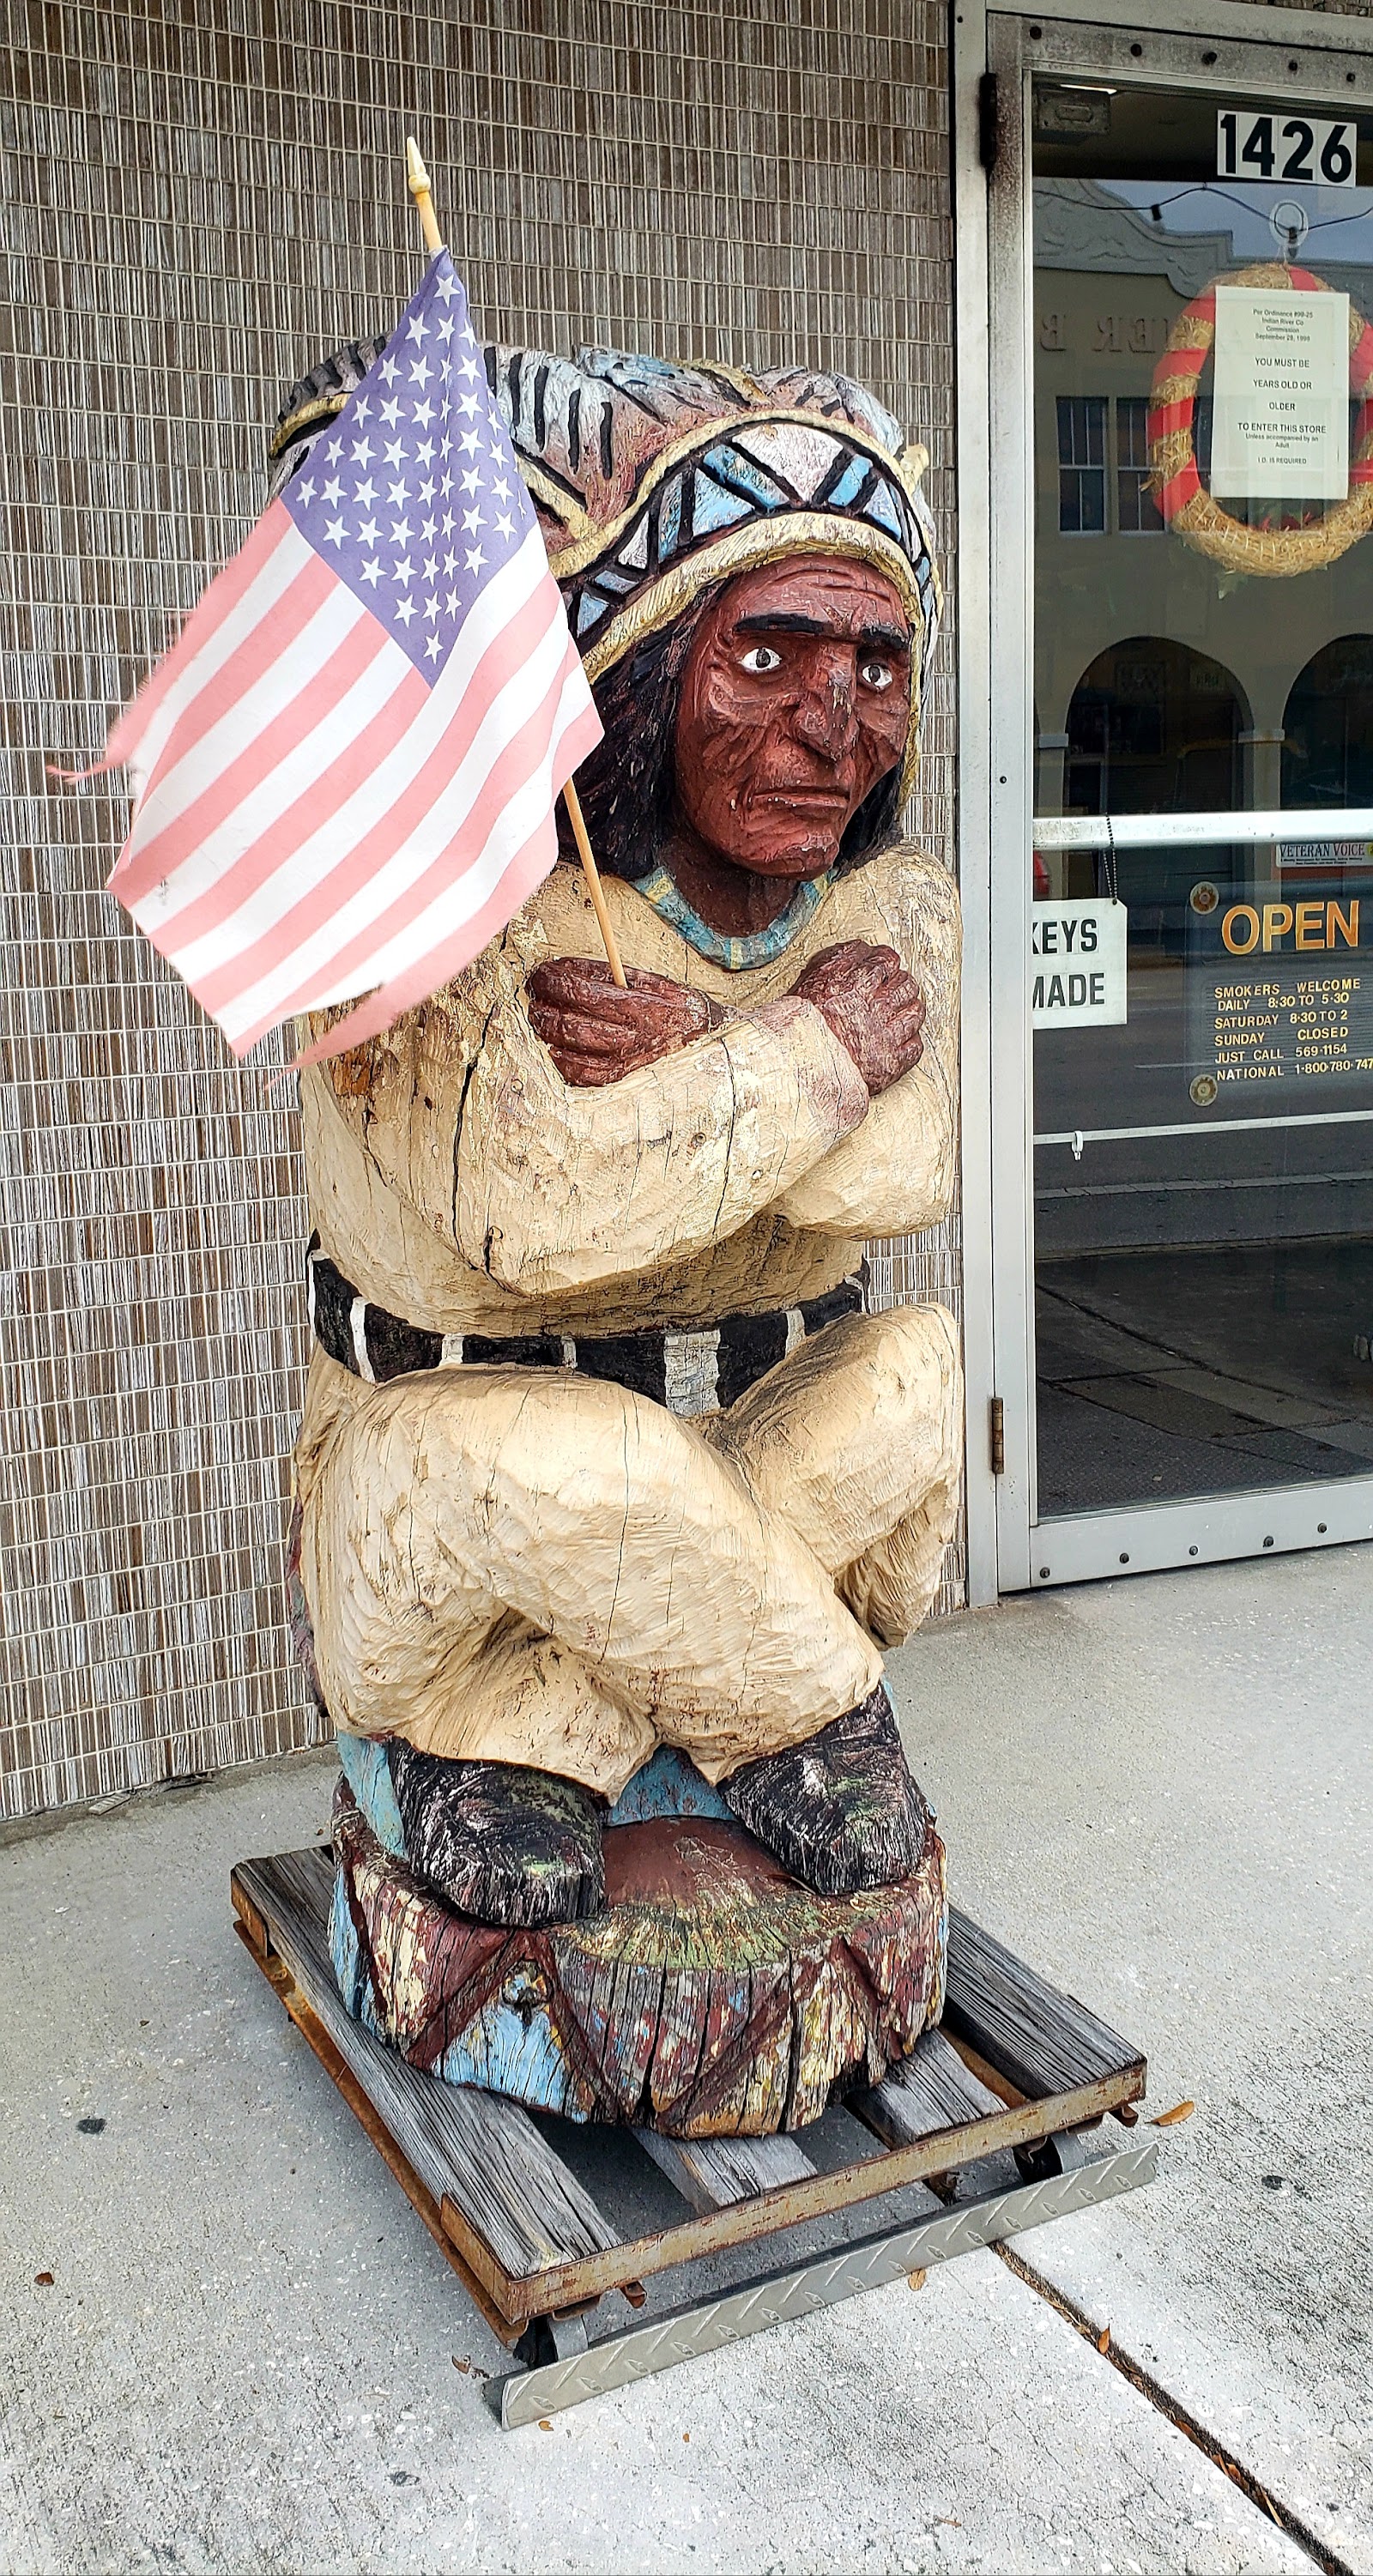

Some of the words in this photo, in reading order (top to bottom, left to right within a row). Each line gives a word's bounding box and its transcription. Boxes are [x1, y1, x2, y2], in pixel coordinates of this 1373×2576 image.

[1220, 114, 1352, 183] 1426
[1255, 357, 1273, 366] YOU
[1274, 359, 1297, 367] MUST
[1298, 360, 1310, 368] BE
[1253, 379, 1279, 389] YEARS
[1280, 381, 1298, 390] OLD
[1299, 381, 1312, 390] OR
[1269, 402, 1296, 411] OLDER
[1237, 422, 1249, 431] TO
[1251, 423, 1279, 432] ENTER
[1279, 424, 1297, 432] THIS
[1266, 434, 1303, 443] accompanied
[1279, 844, 1330, 857] VETERAN
[1334, 844, 1365, 856] VOICE
[1221, 900, 1359, 955] OPEN
[1214, 983, 1280, 999] SMOKERS
[1297, 978, 1361, 993] WELCOME
[1218, 999, 1250, 1012] DAILY
[1267, 995, 1296, 1008] 8:30
[1298, 995, 1315, 1007] TO
[1214, 1014, 1279, 1030] SATURDAY
[1319, 1010, 1337, 1022] TO
[1340, 1009, 1348, 1020] 2
[1214, 1032, 1265, 1047] SUNDAY
[1297, 1026, 1349, 1041] CLOSED
[1214, 1051, 1245, 1064] JUST
[1253, 1049, 1284, 1061] CALL
[1217, 1066, 1285, 1081] NATIONAL
